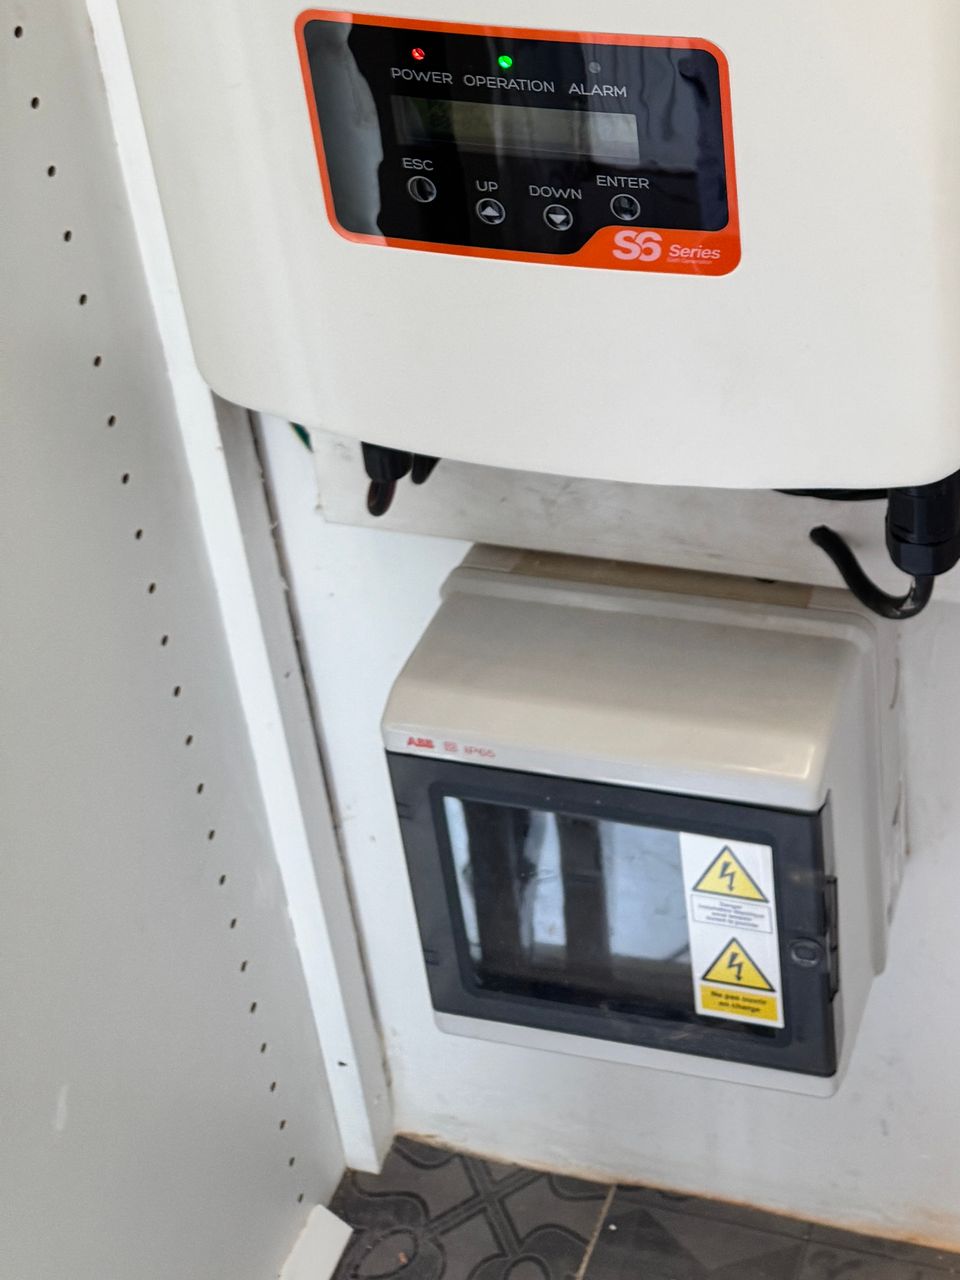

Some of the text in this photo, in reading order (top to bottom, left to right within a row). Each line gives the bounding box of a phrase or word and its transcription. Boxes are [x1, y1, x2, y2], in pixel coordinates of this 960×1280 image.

[390, 66, 454, 85] POWER
[463, 74, 556, 94] OPERATION
[568, 83, 627, 98] ALARM
[402, 157, 434, 172] ESC
[476, 180, 499, 193] UP
[596, 174, 650, 190] ENTER
[528, 184, 582, 200] DOWN
[612, 230, 663, 262] S6
[668, 243, 721, 260] Series
